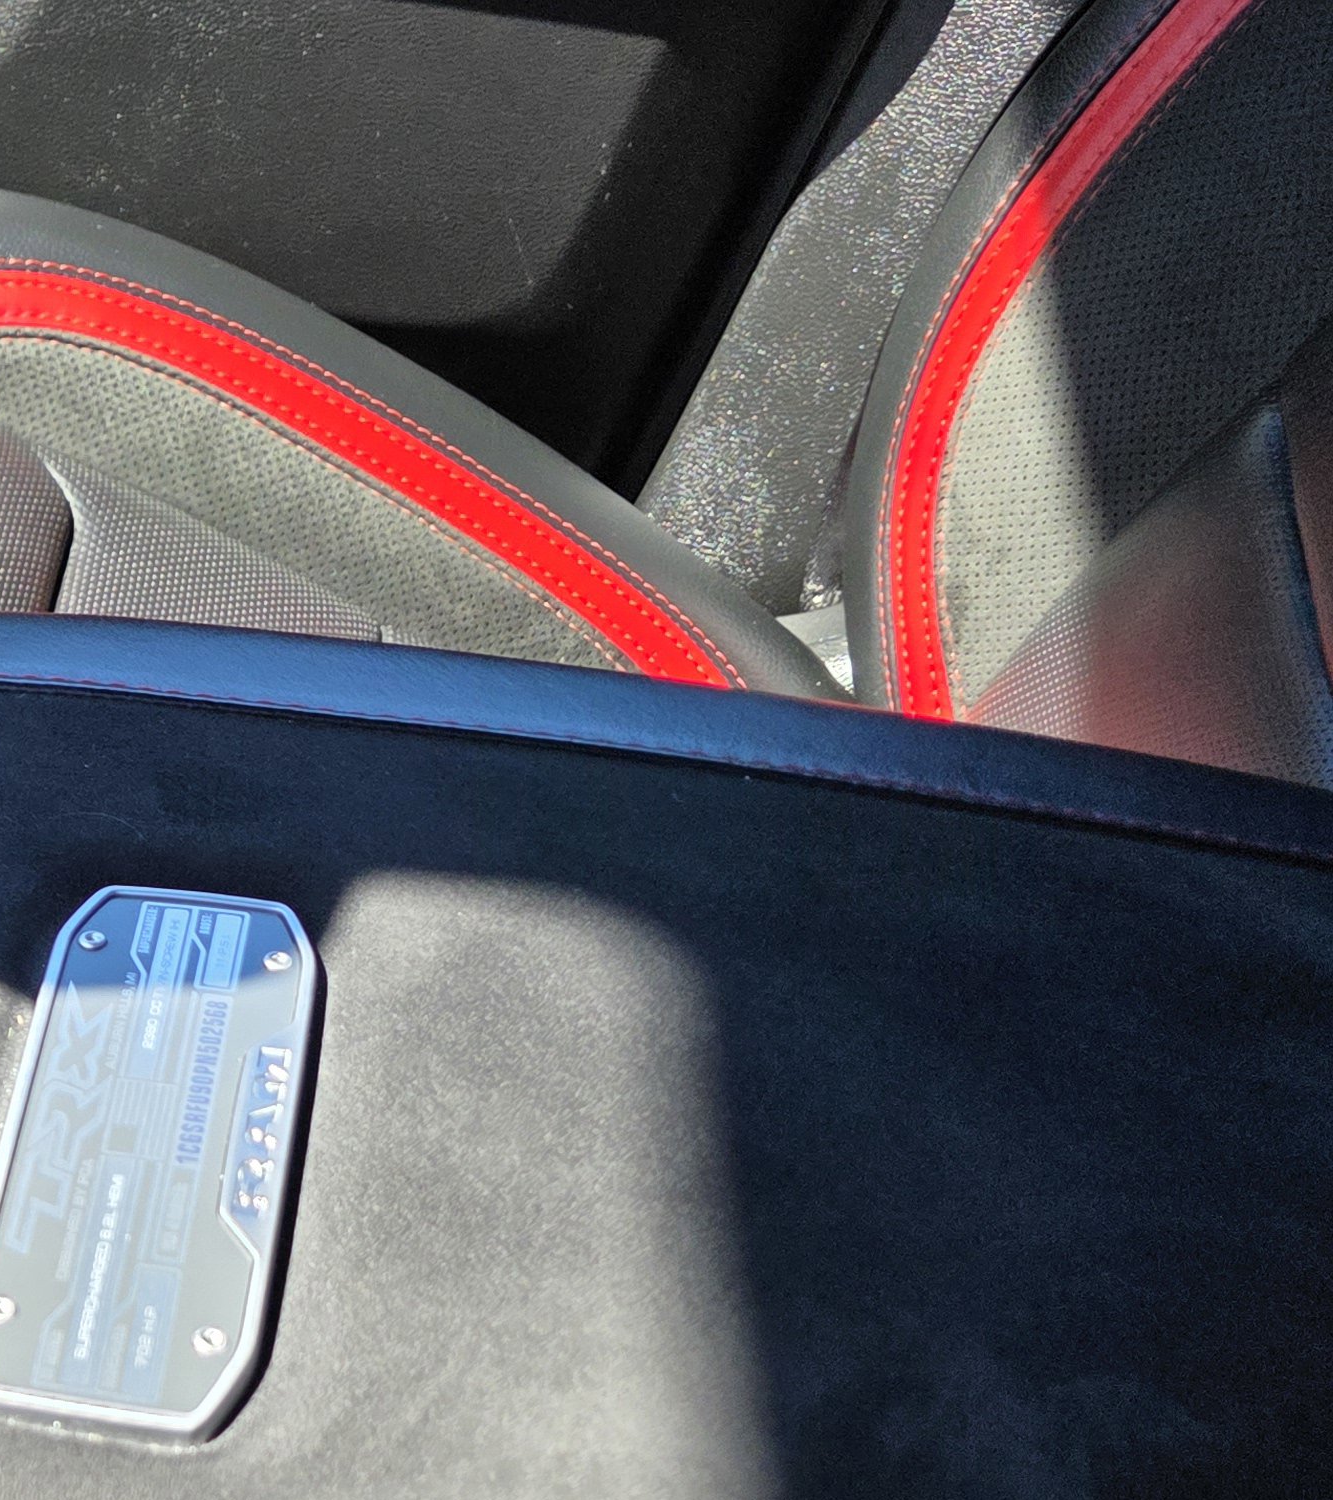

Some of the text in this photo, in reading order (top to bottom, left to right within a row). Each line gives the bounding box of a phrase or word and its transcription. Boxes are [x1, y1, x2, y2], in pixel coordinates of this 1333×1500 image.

[4, 979, 113, 1253] TRX
[104, 1019, 125, 1069] AUBURN
[73, 1241, 112, 1360] SUPERCHARGED
[106, 1173, 126, 1207] HEMI
